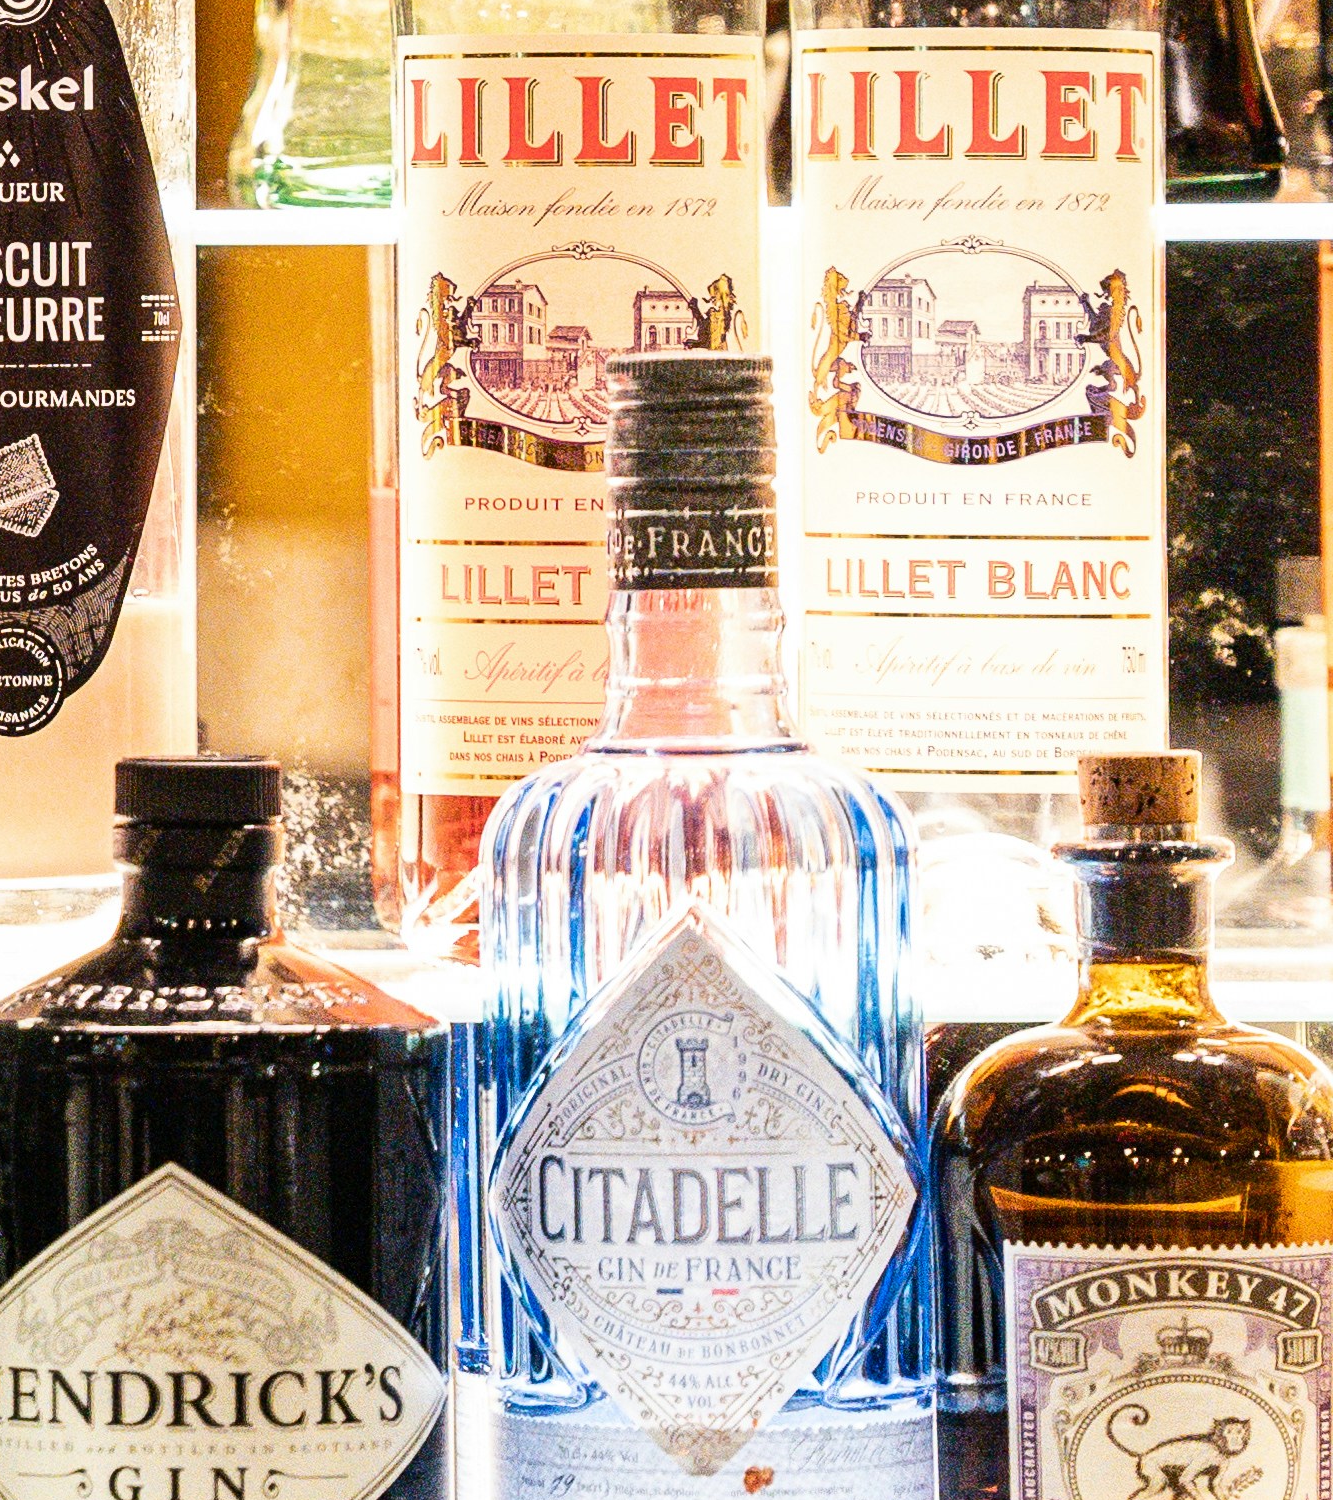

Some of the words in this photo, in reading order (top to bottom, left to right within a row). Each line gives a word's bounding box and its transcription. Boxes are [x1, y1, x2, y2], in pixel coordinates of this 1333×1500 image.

[410, 75, 748, 168] LILLET
[807, 69, 1148, 163] LILLET
[442, 180, 536, 217] Maison
[533, 186, 621, 227] fondée
[626, 204, 655, 217] en
[662, 198, 719, 219] 1872
[855, 490, 952, 506] PRODUIT
[962, 492, 993, 506] EN
[1004, 492, 1094, 507] FRANCE
[30, 543, 99, 585] BRETONS
[646, 526, 775, 560] FRANCE
[27, 585, 48, 602] de
[52, 578, 74, 597] 50
[76, 558, 106, 586] ANS
[440, 564, 592, 606] LILLET
[825, 557, 966, 600] LILLET
[986, 559, 1133, 601] BLANC
[538, 1153, 861, 1246] CITADELLE
[597, 1255, 646, 1283] GIN
[653, 1260, 680, 1281] DE
[685, 1254, 803, 1283] FRANCE
[1044, 1264, 1261, 1332] MONKEY
[1264, 1274, 1320, 1328] 47
[593, 1313, 672, 1358] CHÂTEAU
